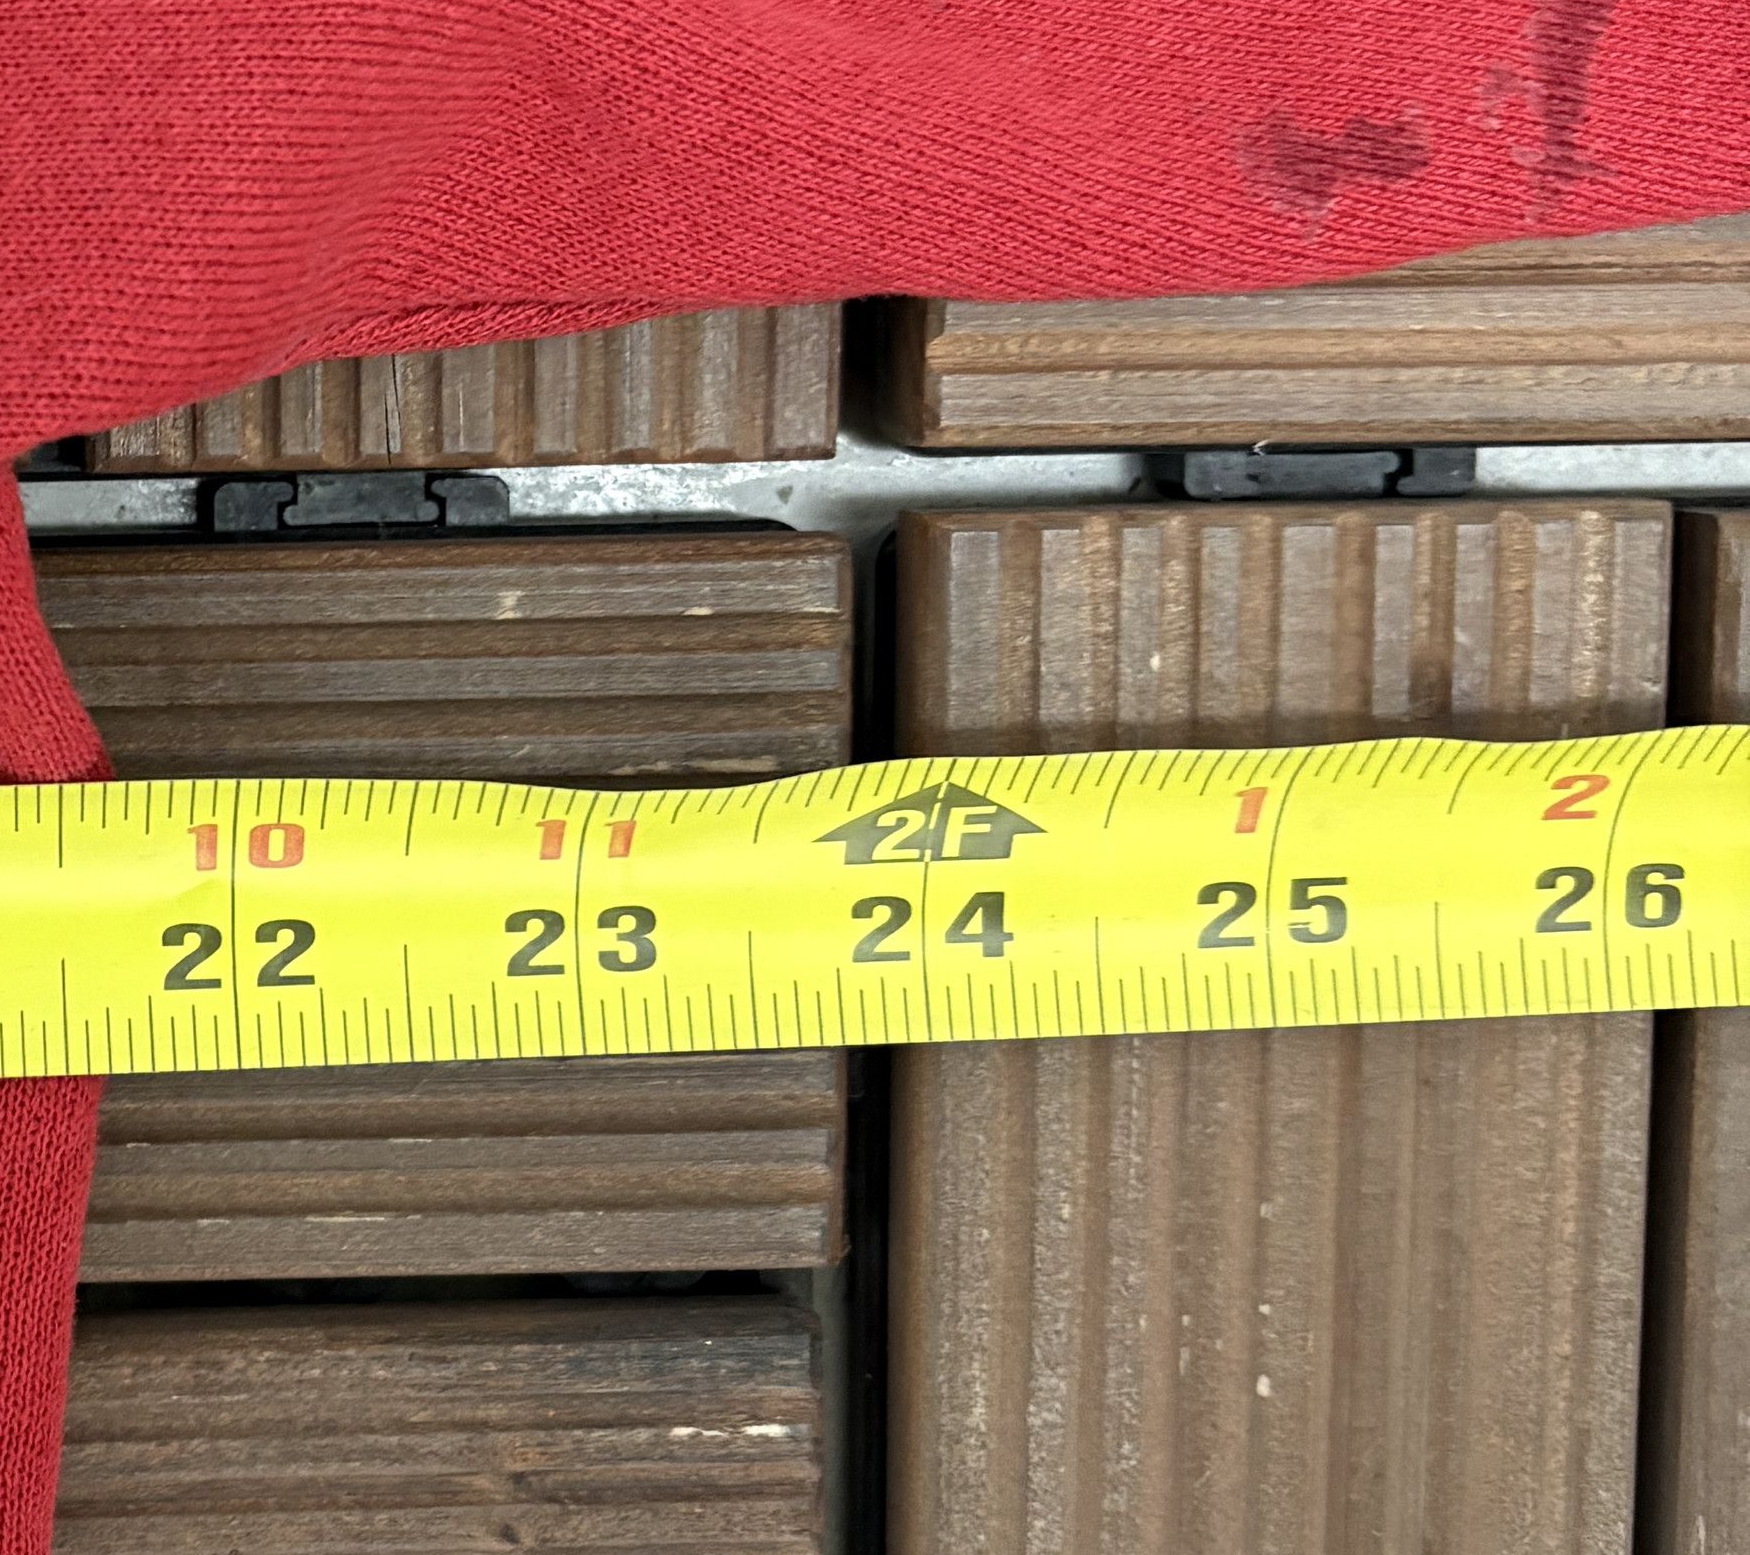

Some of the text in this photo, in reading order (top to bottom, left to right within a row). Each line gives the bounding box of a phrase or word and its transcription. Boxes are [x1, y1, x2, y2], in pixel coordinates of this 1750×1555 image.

[186, 822, 305, 871] 10
[534, 820, 638, 860] 11
[871, 804, 998, 861] 2F
[1233, 786, 1268, 834] 1
[1541, 775, 1610, 821] 2
[160, 919, 317, 991] 22
[504, 905, 658, 977] 23
[851, 891, 1013, 963] 24
[1197, 876, 1348, 949] 25
[1535, 863, 1686, 934] 26
